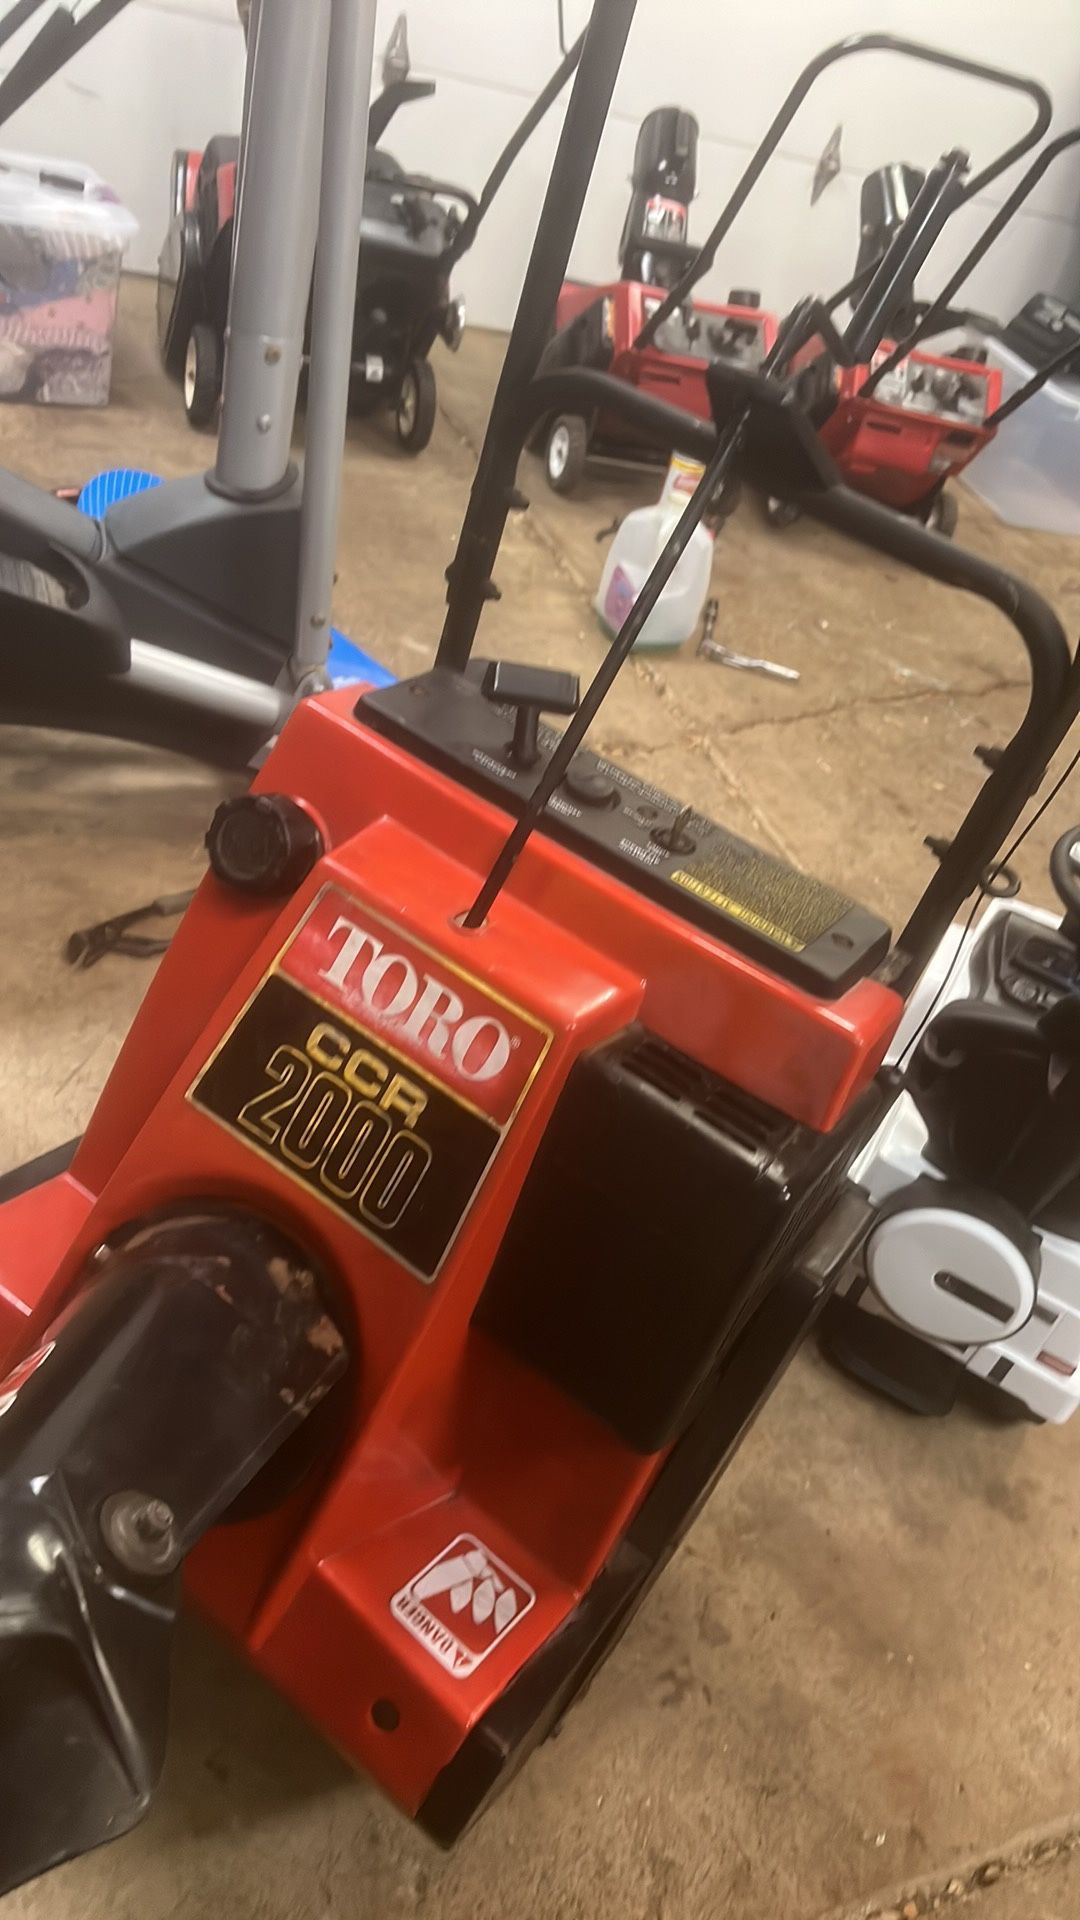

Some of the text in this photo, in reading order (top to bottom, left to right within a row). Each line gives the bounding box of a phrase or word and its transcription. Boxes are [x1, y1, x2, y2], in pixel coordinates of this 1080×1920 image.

[317, 915, 511, 1084] TORO
[236, 1044, 434, 1230] 2000
[305, 1021, 430, 1129] CCR
[397, 1595, 453, 1654] DANGER
